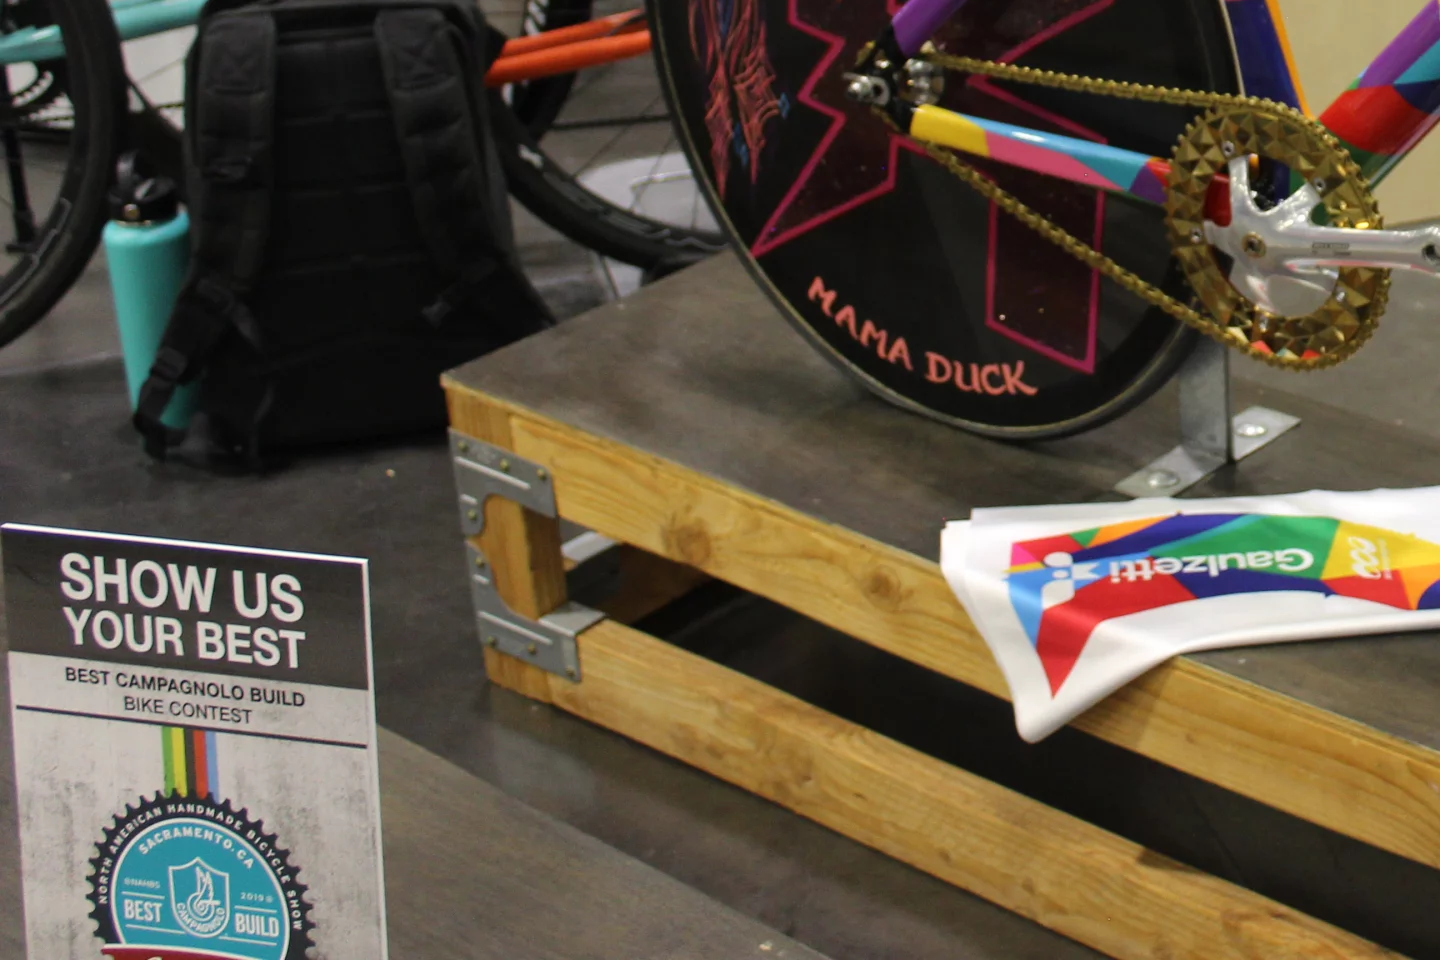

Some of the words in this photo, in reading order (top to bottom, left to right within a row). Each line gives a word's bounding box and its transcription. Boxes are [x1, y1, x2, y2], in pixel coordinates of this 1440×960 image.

[808, 276, 913, 371] MAMA
[925, 351, 1038, 395] DUCK
[1109, 548, 1313, 583] Gaulzetti
[60, 552, 217, 613] SHOW
[232, 570, 304, 622] US
[63, 607, 184, 657] YOUR
[197, 621, 306, 668] BEST
[66, 667, 110, 685] BEST
[116, 672, 244, 700] CAMPAGNOLO
[250, 688, 305, 707] BUILD
[124, 696, 164, 713] BIKE
[169, 701, 253, 724] CONTEST
[99, 858, 114, 904] NORTH
[109, 807, 163, 855] AMERICAN
[167, 804, 243, 830] HANDMADE
[246, 829, 291, 884] BICYCLE
[286, 890, 303, 931] SHOW
[236, 849, 255, 869] CA
[124, 898, 163, 922] BEST
[235, 913, 280, 937] BUILD
